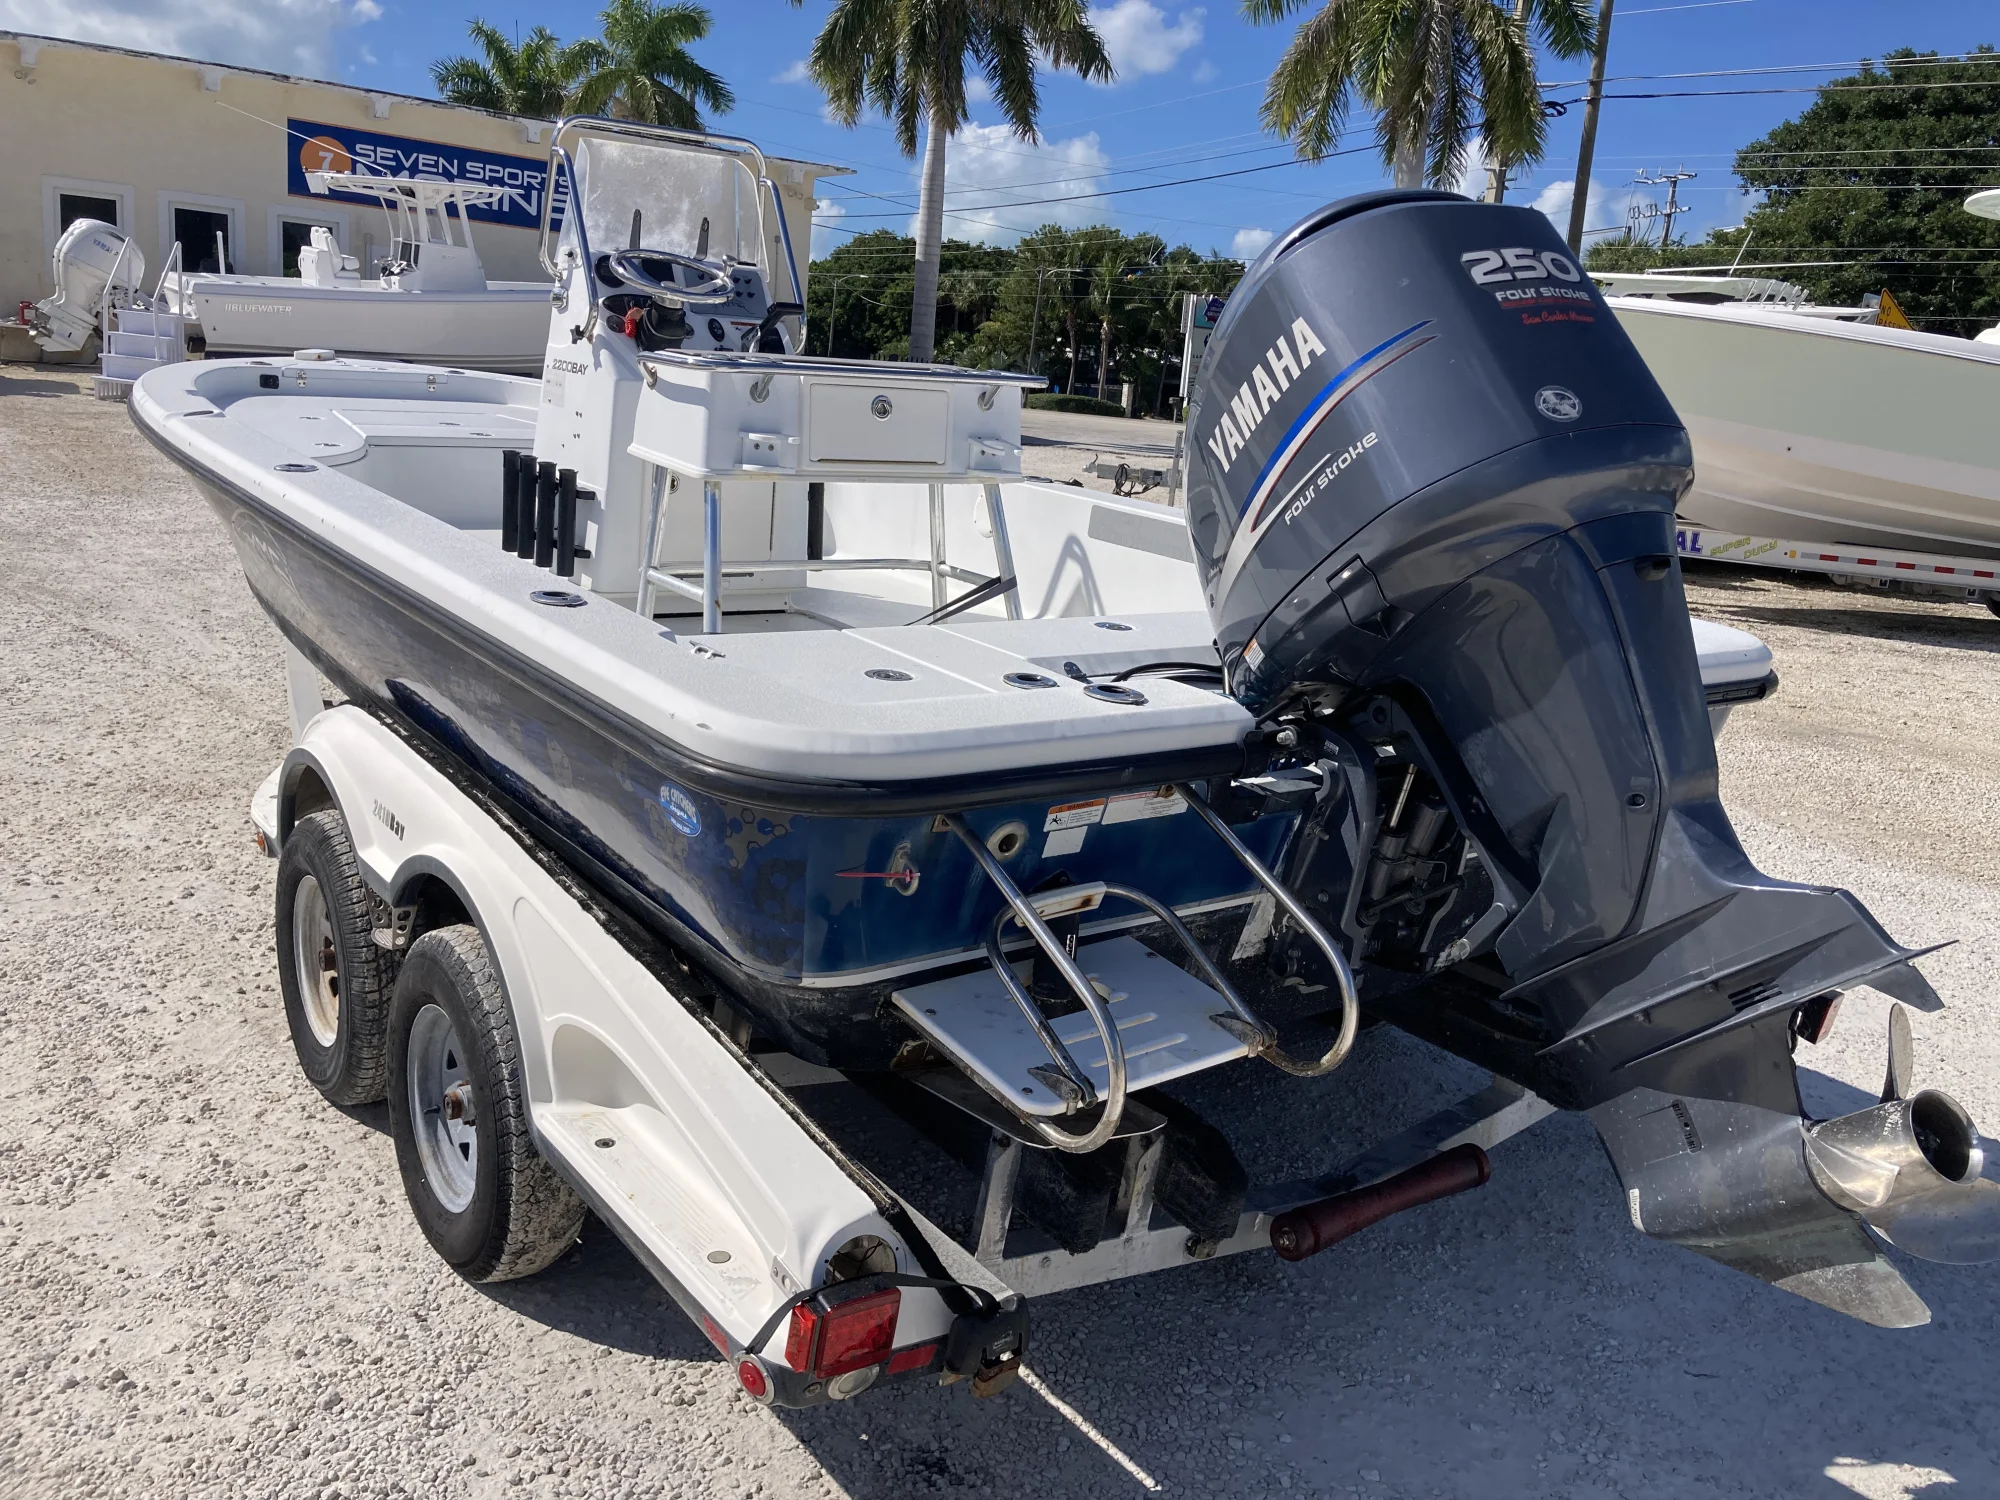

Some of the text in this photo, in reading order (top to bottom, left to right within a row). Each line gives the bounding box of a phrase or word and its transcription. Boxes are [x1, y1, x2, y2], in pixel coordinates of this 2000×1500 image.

[318, 151, 334, 171] 7
[355, 143, 458, 176] SEVEN
[355, 163, 568, 219] MRINE
[1461, 247, 1581, 285] 250
[231, 303, 292, 316] BLUEWATER
[1880, 305, 1892, 317] NO
[1878, 318, 1907, 329] PASS
[552, 358, 589, 375] 2200BAY
[1207, 316, 1327, 474] YAMAHA
[1709, 536, 1751, 558] SUPER
